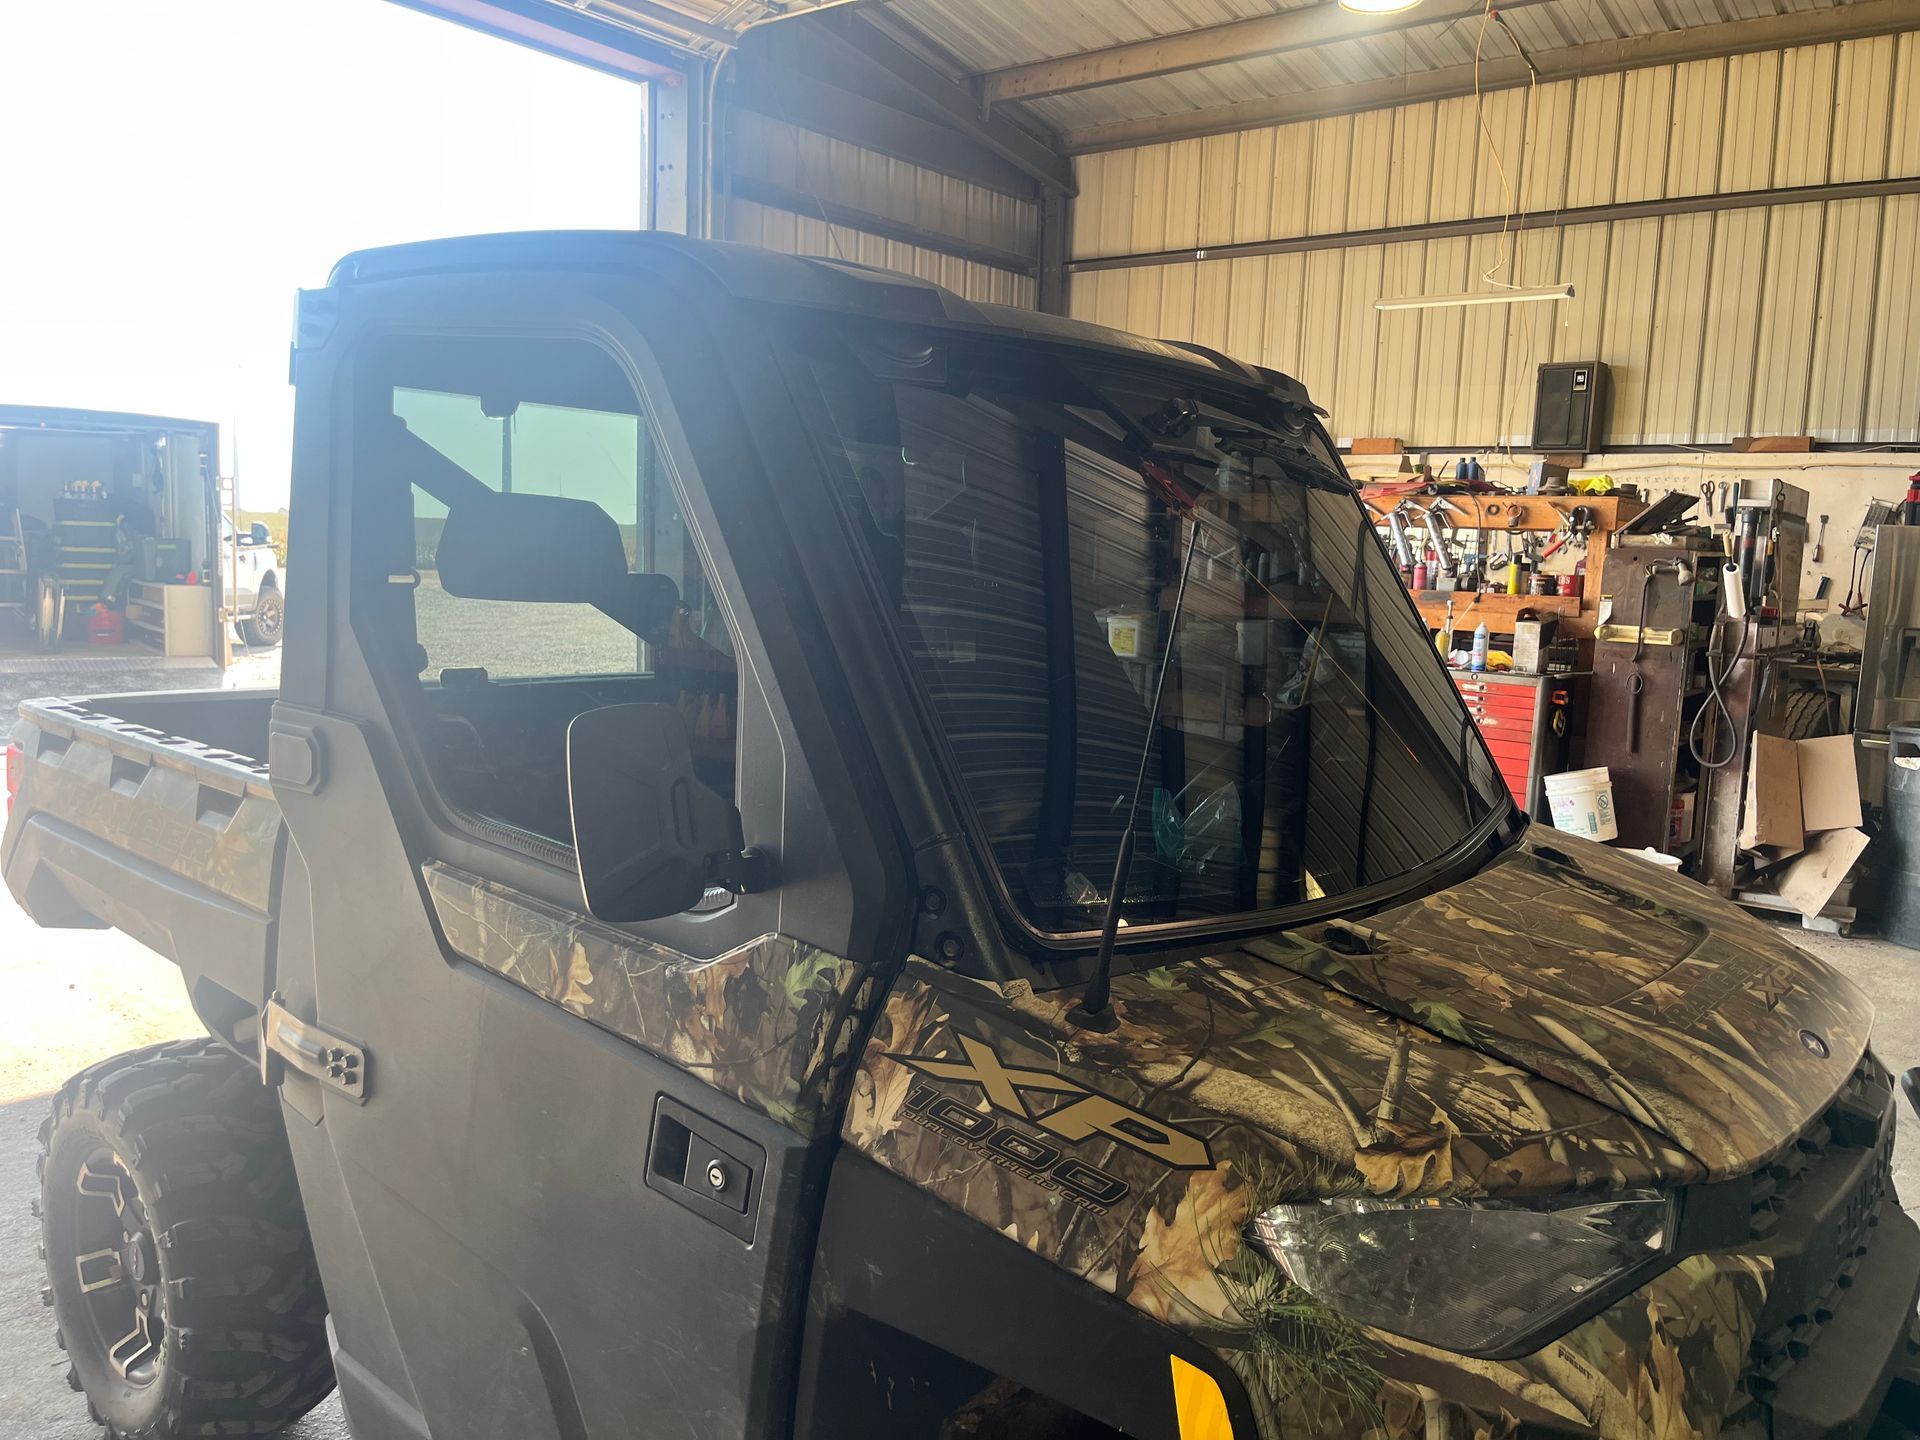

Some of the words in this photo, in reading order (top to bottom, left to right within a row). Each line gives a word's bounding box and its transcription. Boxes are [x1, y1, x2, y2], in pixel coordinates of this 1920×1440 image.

[1661, 952, 1763, 1030] RANGER
[1750, 963, 1794, 1013] XP
[882, 1028, 1216, 1169] XP
[904, 1082, 1130, 1206] 1000
[901, 1110, 949, 1139] DUAL
[952, 1135, 1060, 1192] OVERHEAD
[1058, 1190, 1110, 1217] CAM
[1558, 1347, 1593, 1380] PURSUIT
